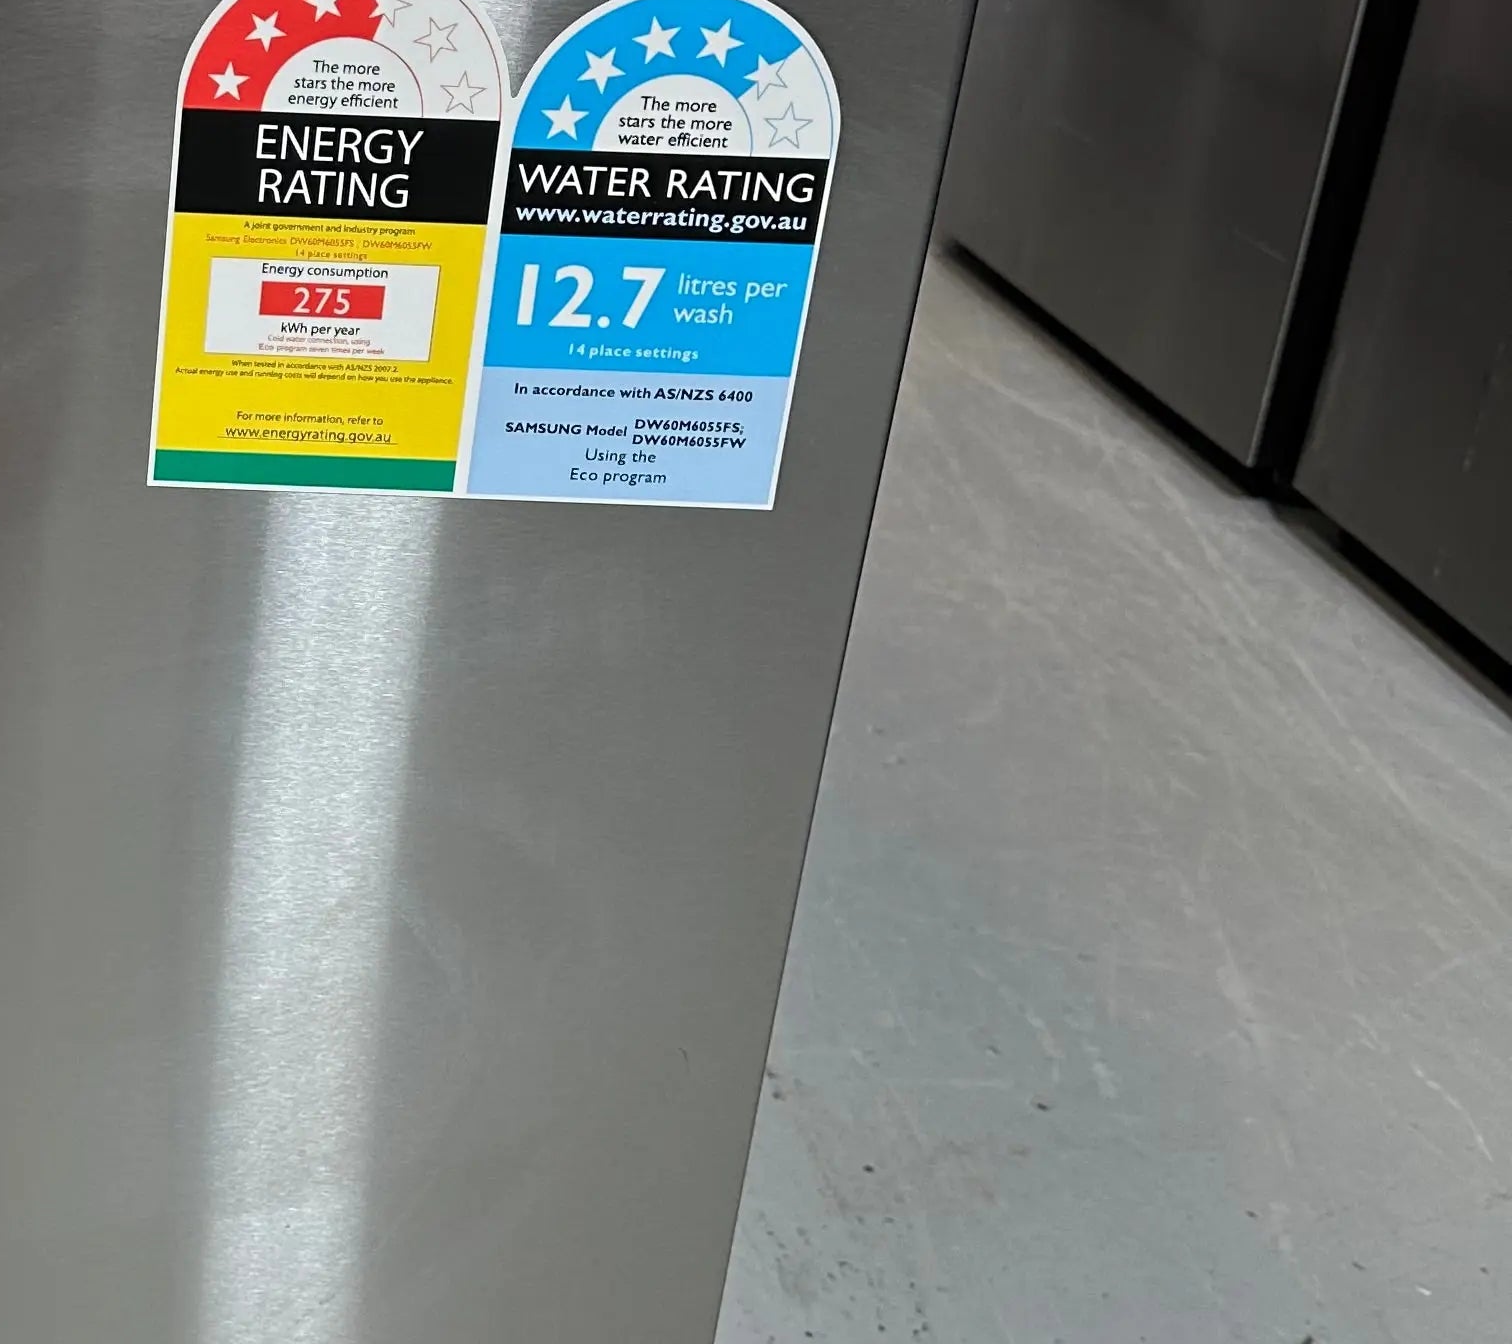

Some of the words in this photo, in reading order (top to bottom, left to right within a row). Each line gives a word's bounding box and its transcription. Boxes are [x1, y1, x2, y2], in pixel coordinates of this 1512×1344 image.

[312, 59, 340, 74] The
[342, 63, 381, 76] more
[293, 76, 328, 90] stars
[330, 76, 355, 91] the
[357, 80, 396, 93] more
[287, 93, 338, 110] energy
[340, 93, 400, 109] efficient
[640, 95, 670, 111] The
[674, 100, 718, 113] more
[618, 116, 656, 129] stars
[660, 114, 686, 129] the
[690, 118, 733, 131] more
[255, 124, 424, 166] ENERGY
[617, 134, 664, 147] water
[668, 132, 729, 148] efficient
[257, 168, 411, 209] RATING
[518, 163, 652, 199] WATER
[666, 168, 816, 203] RATING
[243, 220, 251, 229] A
[251, 220, 272, 231] joint
[272, 222, 324, 233] government
[325, 223, 342, 233] and
[343, 224, 378, 236] industry
[378, 226, 416, 237] program
[515, 206, 809, 234] www.waterrating.gov.au
[295, 248, 305, 257] 14
[307, 250, 331, 260] place
[333, 251, 368, 261] settings
[261, 262, 305, 278] Energy
[307, 266, 389, 281] consumption
[292, 286, 351, 315] 275
[516, 263, 667, 329] 12.7
[677, 271, 738, 297] litres
[744, 280, 788, 304] per
[673, 302, 734, 325] wash
[280, 321, 308, 334] kWh
[310, 325, 332, 337] per
[334, 326, 361, 338] year
[568, 342, 586, 357] 14
[588, 343, 632, 360] place
[635, 346, 700, 362] settings
[513, 382, 528, 396] In
[532, 383, 616, 399] accordance
[619, 384, 652, 400] with
[653, 386, 716, 402] AS/NZS
[717, 388, 754, 404] 6400
[236, 410, 253, 421] For
[254, 413, 282, 423] more
[283, 412, 346, 426] information,
[347, 415, 371, 426] refer
[372, 417, 384, 427] to
[504, 421, 583, 435] SAMSUNG
[585, 424, 628, 437] Model
[633, 418, 745, 436] DW60M6055FS;
[224, 426, 393, 445] www.energyrating.gov.au
[631, 434, 747, 449] DW60M6055FW
[584, 447, 627, 466] Using
[631, 448, 657, 464] the
[568, 467, 599, 482] Eco
[602, 470, 668, 487] program
